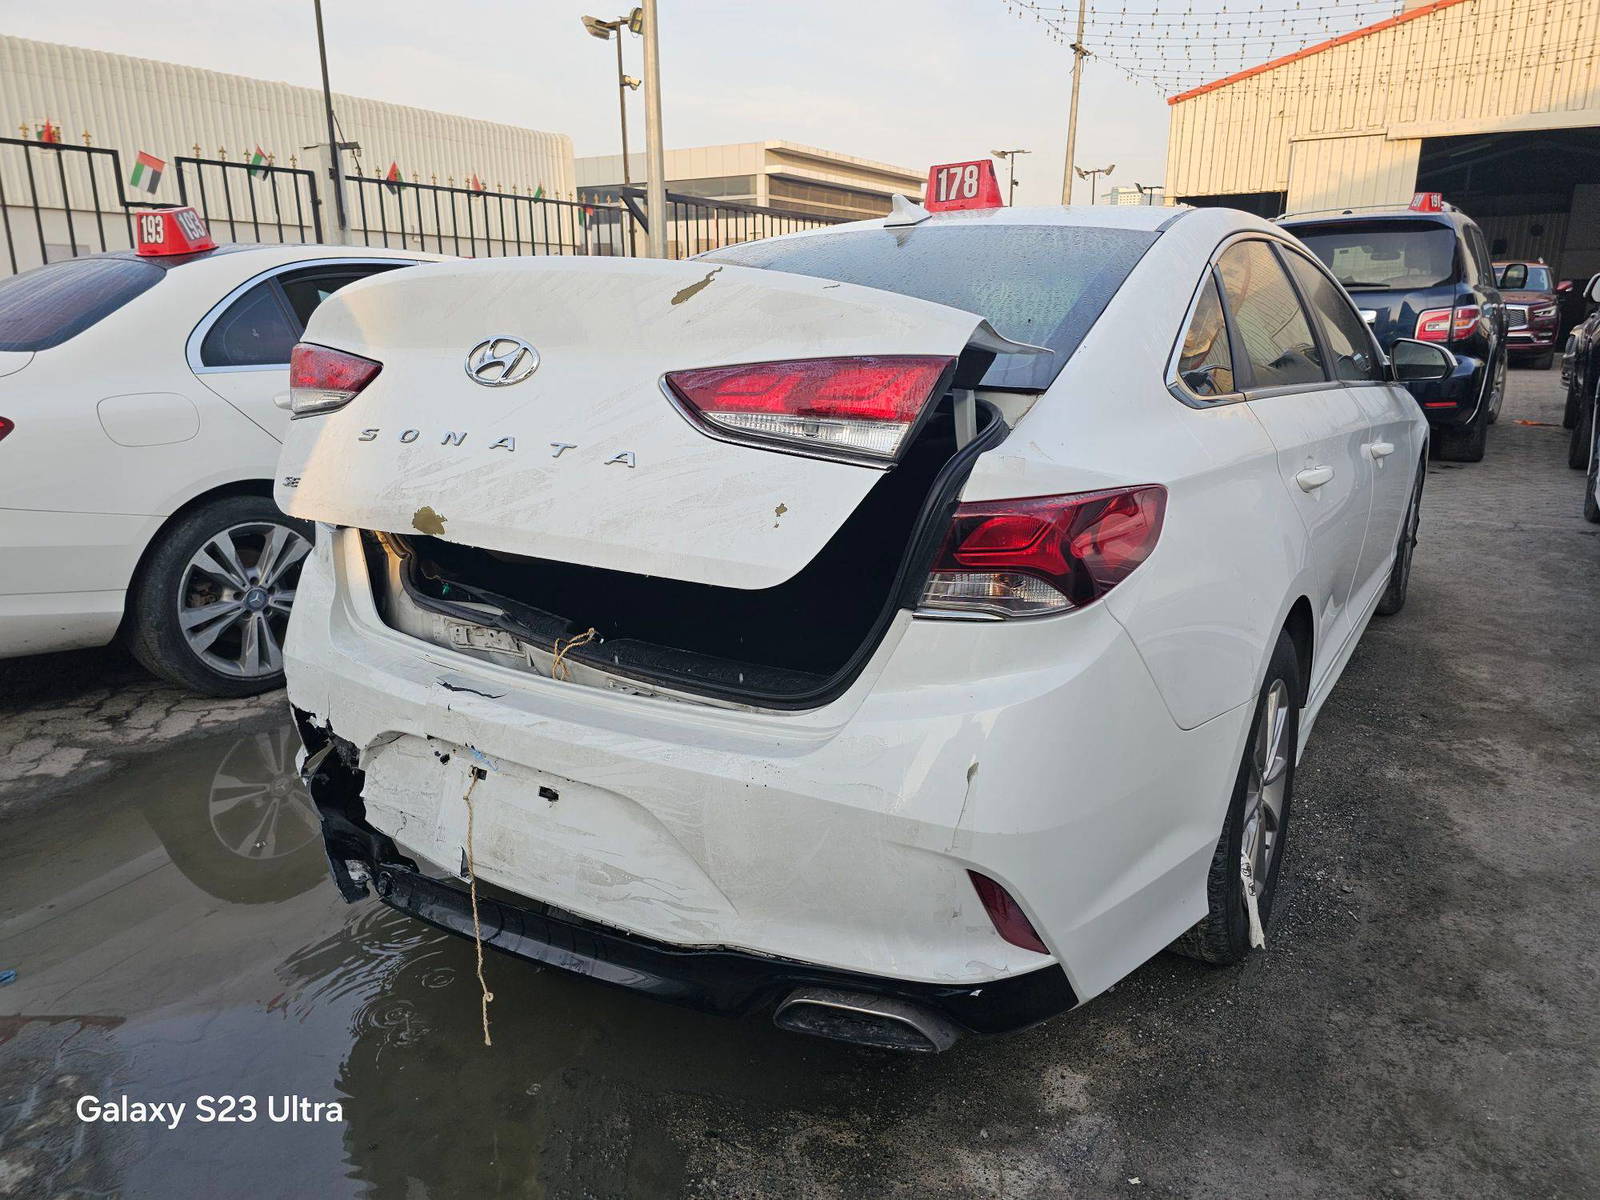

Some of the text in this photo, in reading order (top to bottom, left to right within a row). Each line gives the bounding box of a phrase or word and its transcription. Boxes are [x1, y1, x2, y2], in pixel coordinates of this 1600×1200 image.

[938, 165, 979, 202] 178
[141, 215, 164, 244] 193
[178, 210, 206, 240] 193
[358, 428, 637, 468] SONATA
